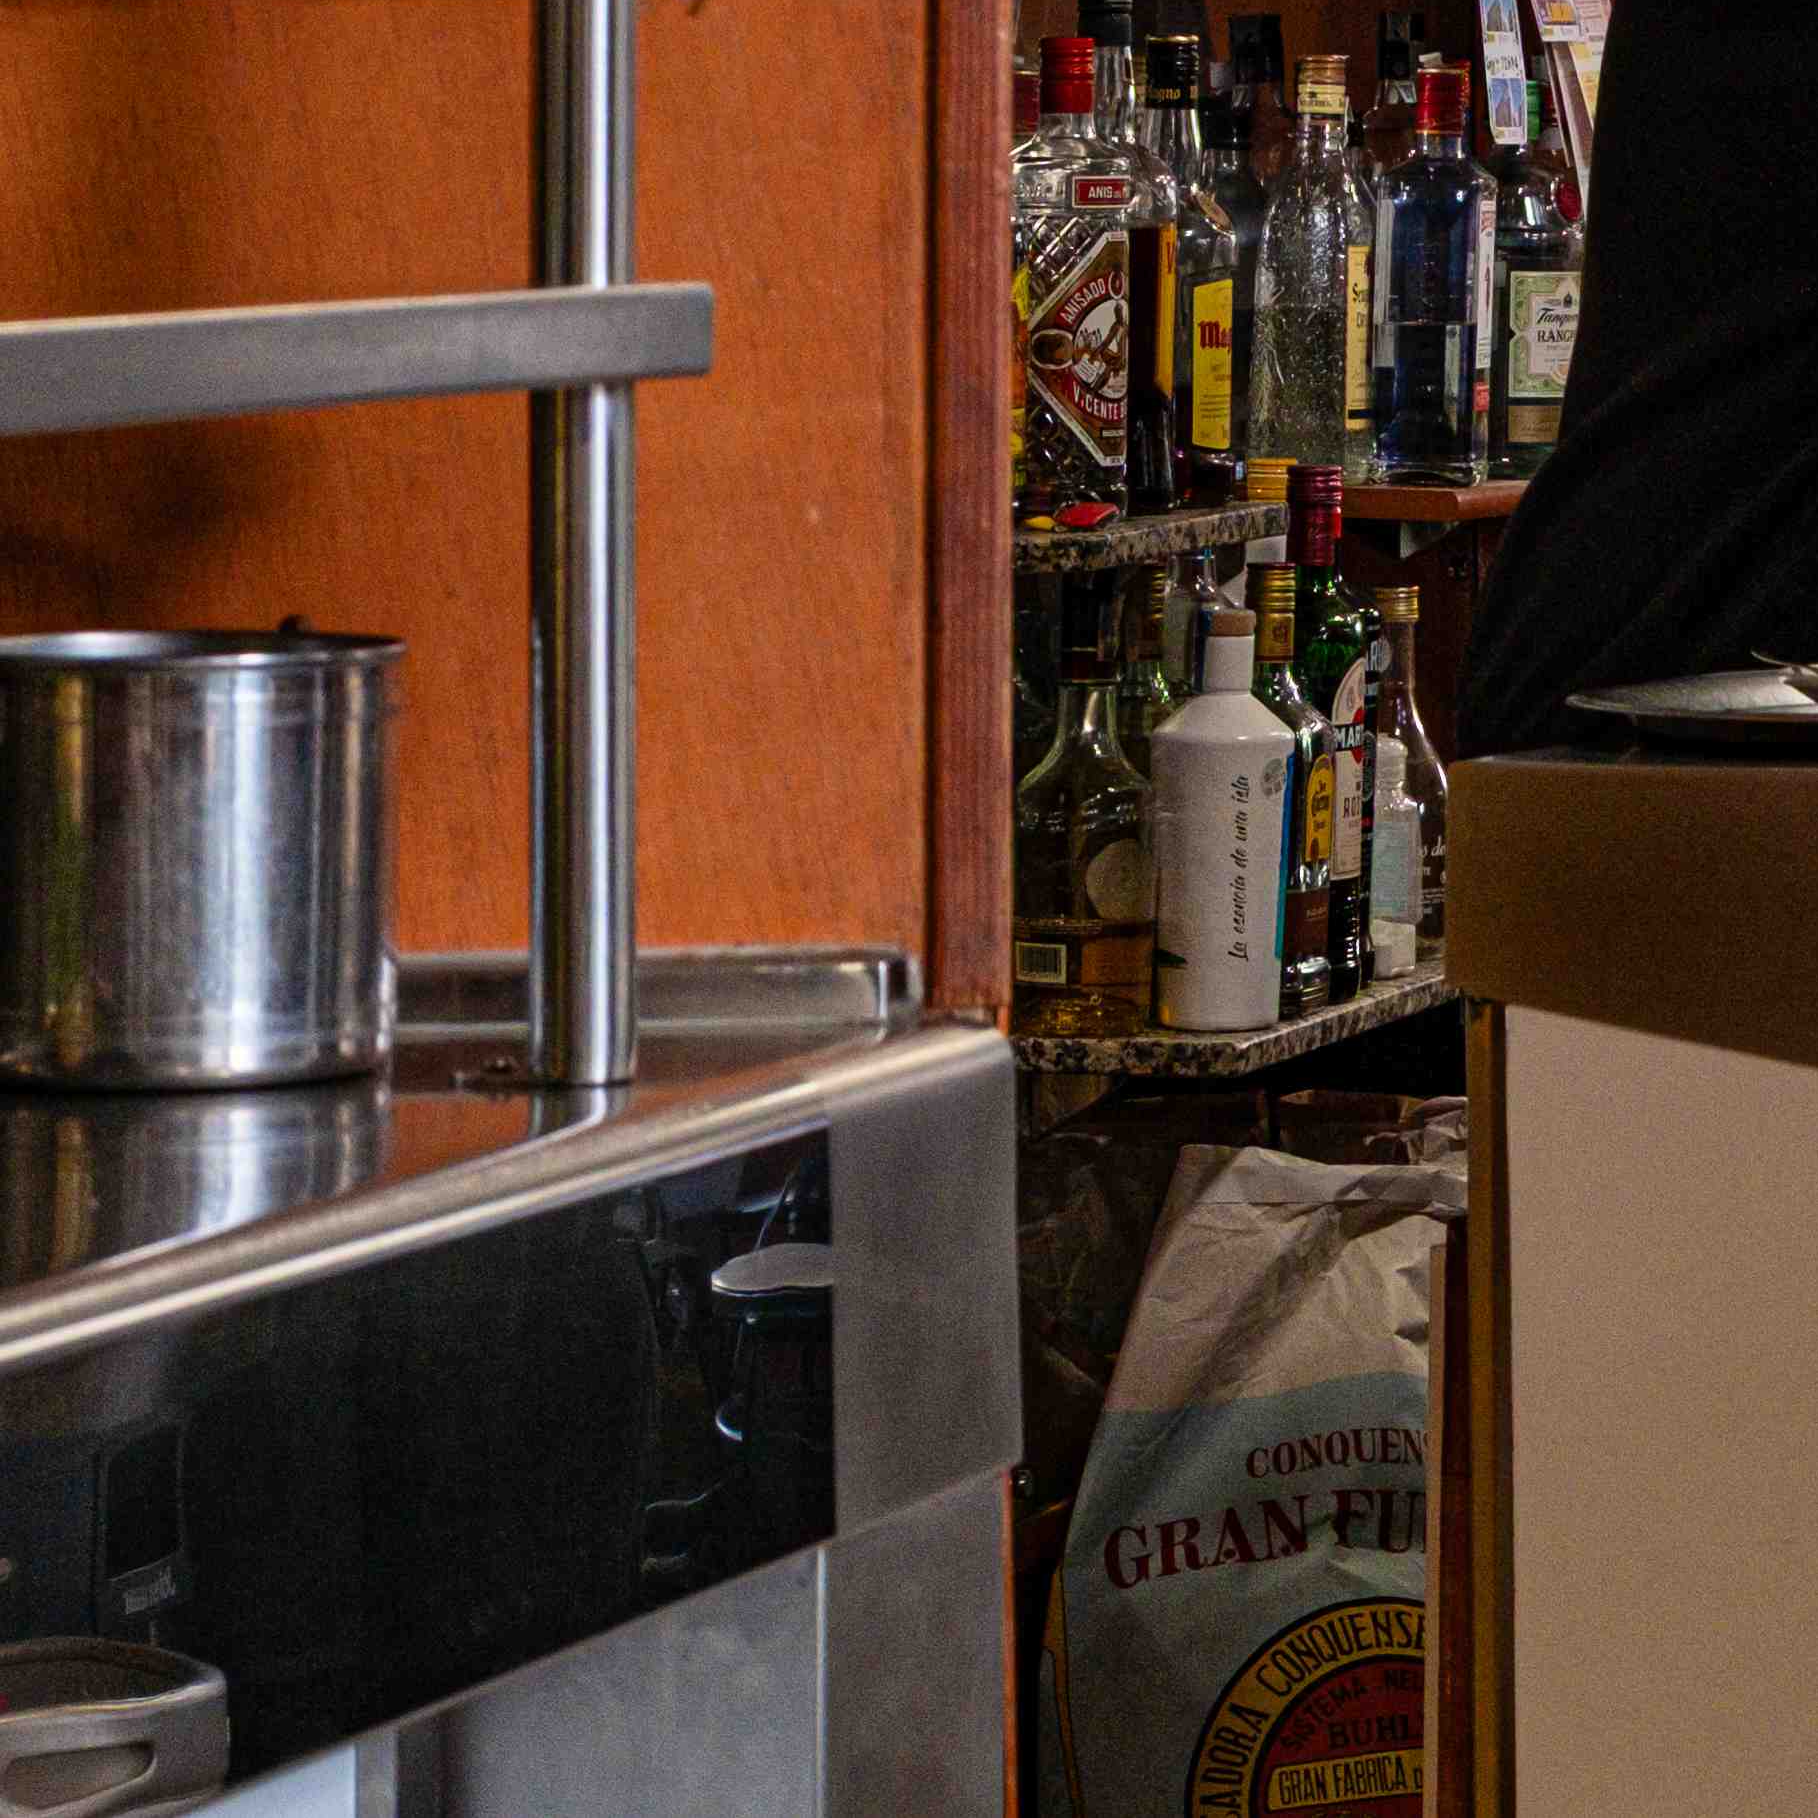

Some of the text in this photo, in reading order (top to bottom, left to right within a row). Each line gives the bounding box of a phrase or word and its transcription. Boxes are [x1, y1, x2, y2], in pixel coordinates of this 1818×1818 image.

[1087, 185, 1113, 200] ANIS
[1062, 277, 1106, 326] ANISADO
[1230, 846, 1247, 868] de
[1230, 874, 1247, 934] esencia
[1228, 941, 1248, 961] La
[1246, 1427, 1426, 1479] CONQUEN
[1104, 1488, 1426, 1589] GRAN FU
[1326, 1712, 1425, 1753] BUHL
[1200, 1700, 1268, 1818] ADORA
[1277, 1767, 1326, 1806] GRAN
[1329, 1753, 1406, 1798] FABRICA
